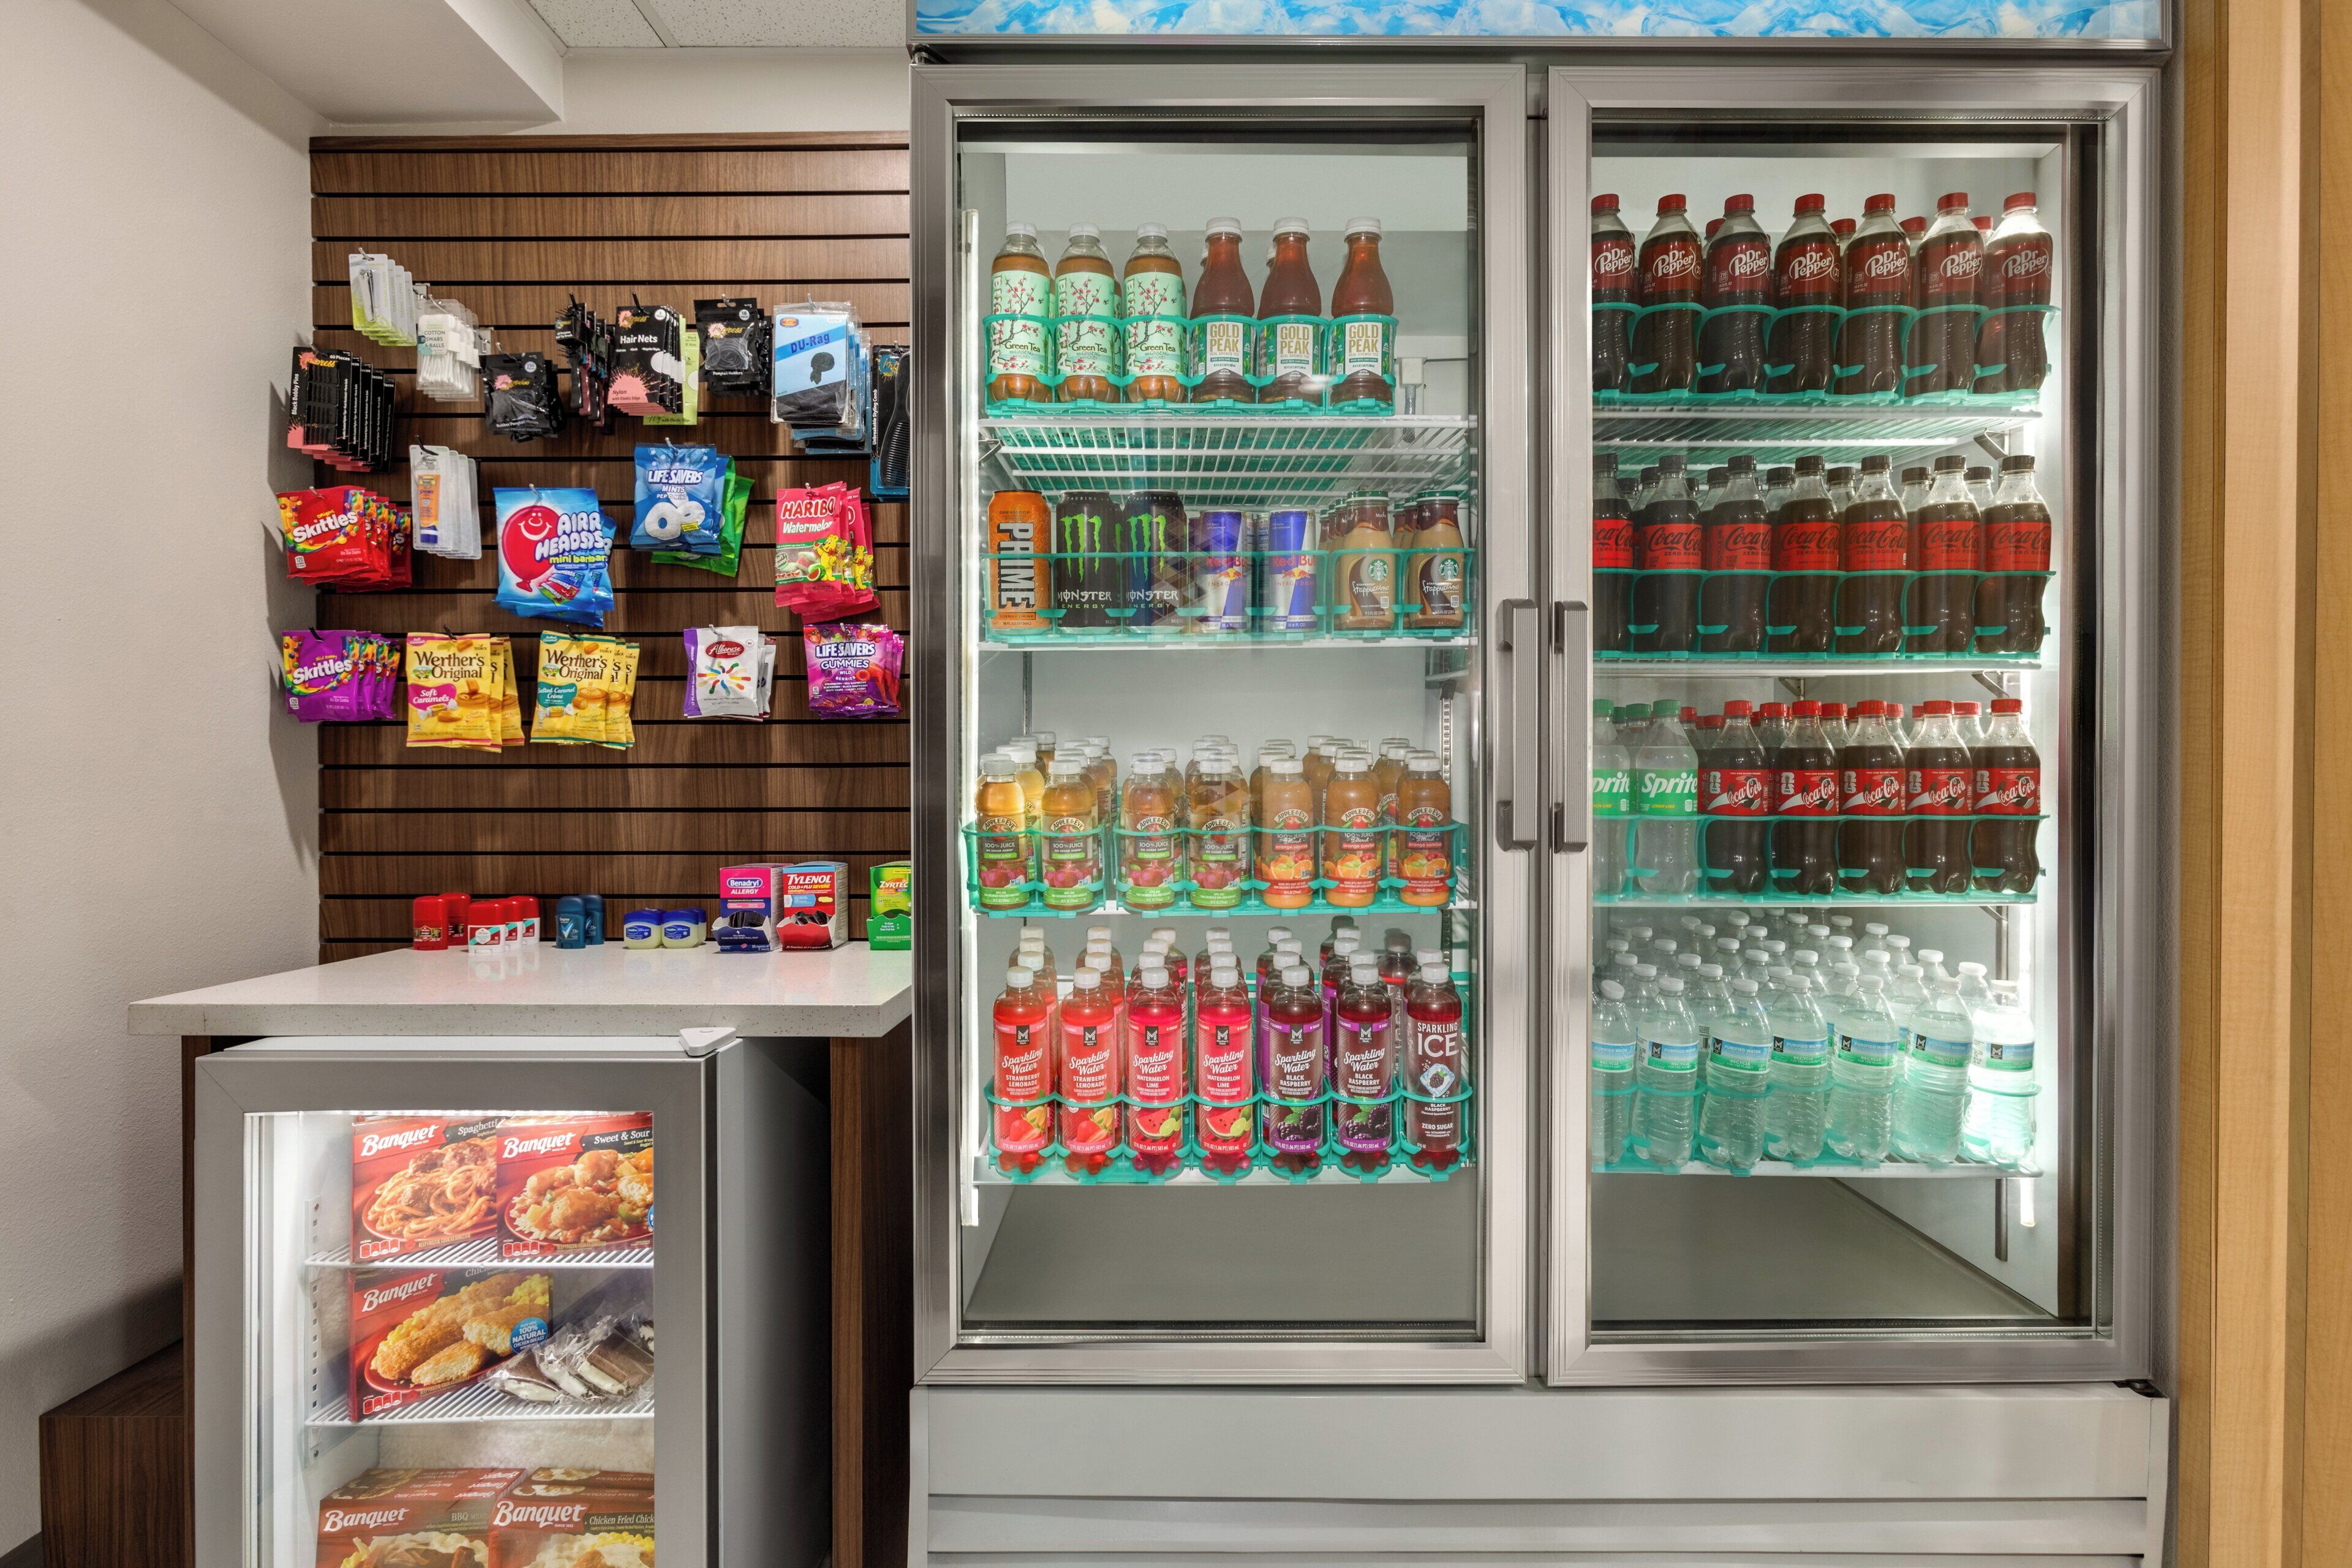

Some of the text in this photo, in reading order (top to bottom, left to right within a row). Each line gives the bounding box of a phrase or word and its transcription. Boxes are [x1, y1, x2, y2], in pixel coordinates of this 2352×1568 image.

[1611, 247, 1626, 259] Dr
[1669, 247, 1686, 260] Dr
[1883, 250, 1900, 263] Dr
[1959, 250, 1975, 262] Dr
[1599, 253, 1633, 275] Pepper
[1657, 254, 1694, 274] Pepper
[1870, 255, 1906, 277] Pepper
[1945, 255, 1983, 277] Pepper
[1210, 323, 1240, 339] GOLD
[1280, 325, 1310, 341] GOLD
[1348, 323, 1379, 338] GOLD
[620, 334, 658, 344] Hair Nets
[790, 333, 830, 354] DU-Rag
[1210, 338, 1239, 353] PEAK
[1349, 338, 1379, 353] PEAK
[1005, 341, 1041, 353] Green Tea
[1071, 342, 1107, 353] Green Tea
[1139, 342, 1175, 353] Green Tea
[1280, 341, 1310, 355] PEAK
[648, 469, 703, 484] LIFE SAVERS
[781, 497, 835, 519] HARIBO
[293, 512, 358, 543] Skittles
[783, 519, 833, 534] Watermelon
[998, 522, 1036, 608] PRIME
[1272, 555, 1296, 567] Red
[1057, 589, 1111, 602] MONSTER
[1125, 589, 1179, 602] MONSTER
[1352, 581, 1389, 597] frappuccino
[709, 644, 741, 655] Albanese
[816, 643, 875, 657] LIFE SAVERS
[413, 650, 485, 667] Werther's
[545, 649, 608, 668] Werther's
[821, 659, 870, 669] GUMMIES
[293, 659, 352, 685] Skittles
[431, 666, 483, 682] Original
[559, 665, 603, 682] Original
[413, 695, 450, 704] Caramels
[420, 688, 438, 697] Soft
[1641, 772, 1697, 798] Sprite
[1864, 777, 1899, 807] Coca-Cola
[1999, 776, 2031, 806] Coca-Cola
[1727, 778, 1762, 808] Coca-Cola
[730, 879, 759, 888] Benadryl
[787, 874, 832, 885] TYLENOL
[1417, 1022, 1458, 1033] SPARKLING
[1417, 1033, 1457, 1058] ICE
[1002, 1048, 1043, 1068] Sparkling
[1133, 1050, 1174, 1067] Sparkling
[1275, 1049, 1316, 1066] Sparkling
[1011, 1063, 1038, 1074] Water
[1140, 1064, 1167, 1074] Water
[1282, 1063, 1310, 1073] Water
[458, 1118, 498, 1136] Spaghetti
[361, 1124, 440, 1156] Banquet
[594, 1133, 619, 1145] Sweet
[630, 1129, 650, 1139] Sour
[502, 1132, 576, 1158] Banquet
[361, 1273, 439, 1312] Banquet
[512, 1329, 546, 1343] NATURAL
[519, 1324, 538, 1334] 100%
[513, 1339, 530, 1348] CHICKEN
[323, 1507, 409, 1531] Banquet
[451, 1512, 469, 1521] BBQ
[493, 1501, 587, 1528] Banquet
[589, 1515, 616, 1525] Chicken
[617, 1514, 635, 1524] Fried
